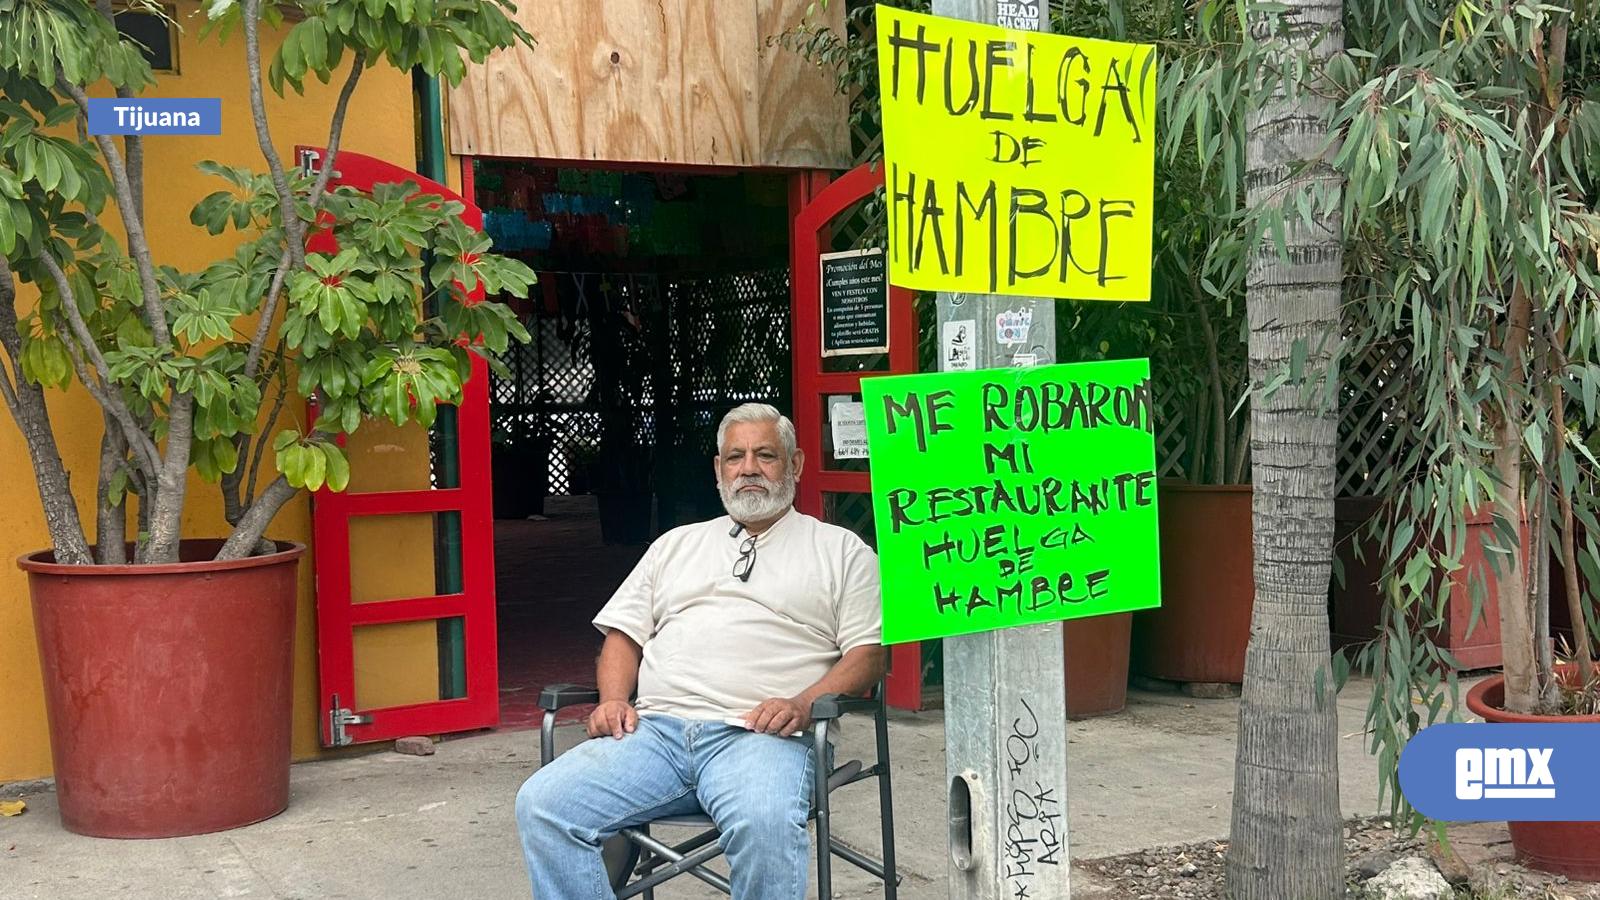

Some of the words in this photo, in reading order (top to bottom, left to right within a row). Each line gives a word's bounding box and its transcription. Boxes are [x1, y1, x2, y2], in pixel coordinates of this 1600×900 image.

[997, 3, 1039, 18] HEAD
[997, 16, 1013, 29] CIA
[1014, 17, 1039, 31] CREW
[888, 20, 1141, 143] HUELGA
[985, 130, 1047, 168] DE
[892, 162, 1136, 292] HAMBRE
[882, 390, 955, 452] ME
[982, 378, 1153, 434] ROBARON
[983, 442, 1034, 474] MI
[887, 471, 1156, 533] RESTAURANTE
[923, 523, 1095, 570] HUELGA
[999, 552, 1034, 579] DE
[934, 569, 1110, 617] HAMBRE
